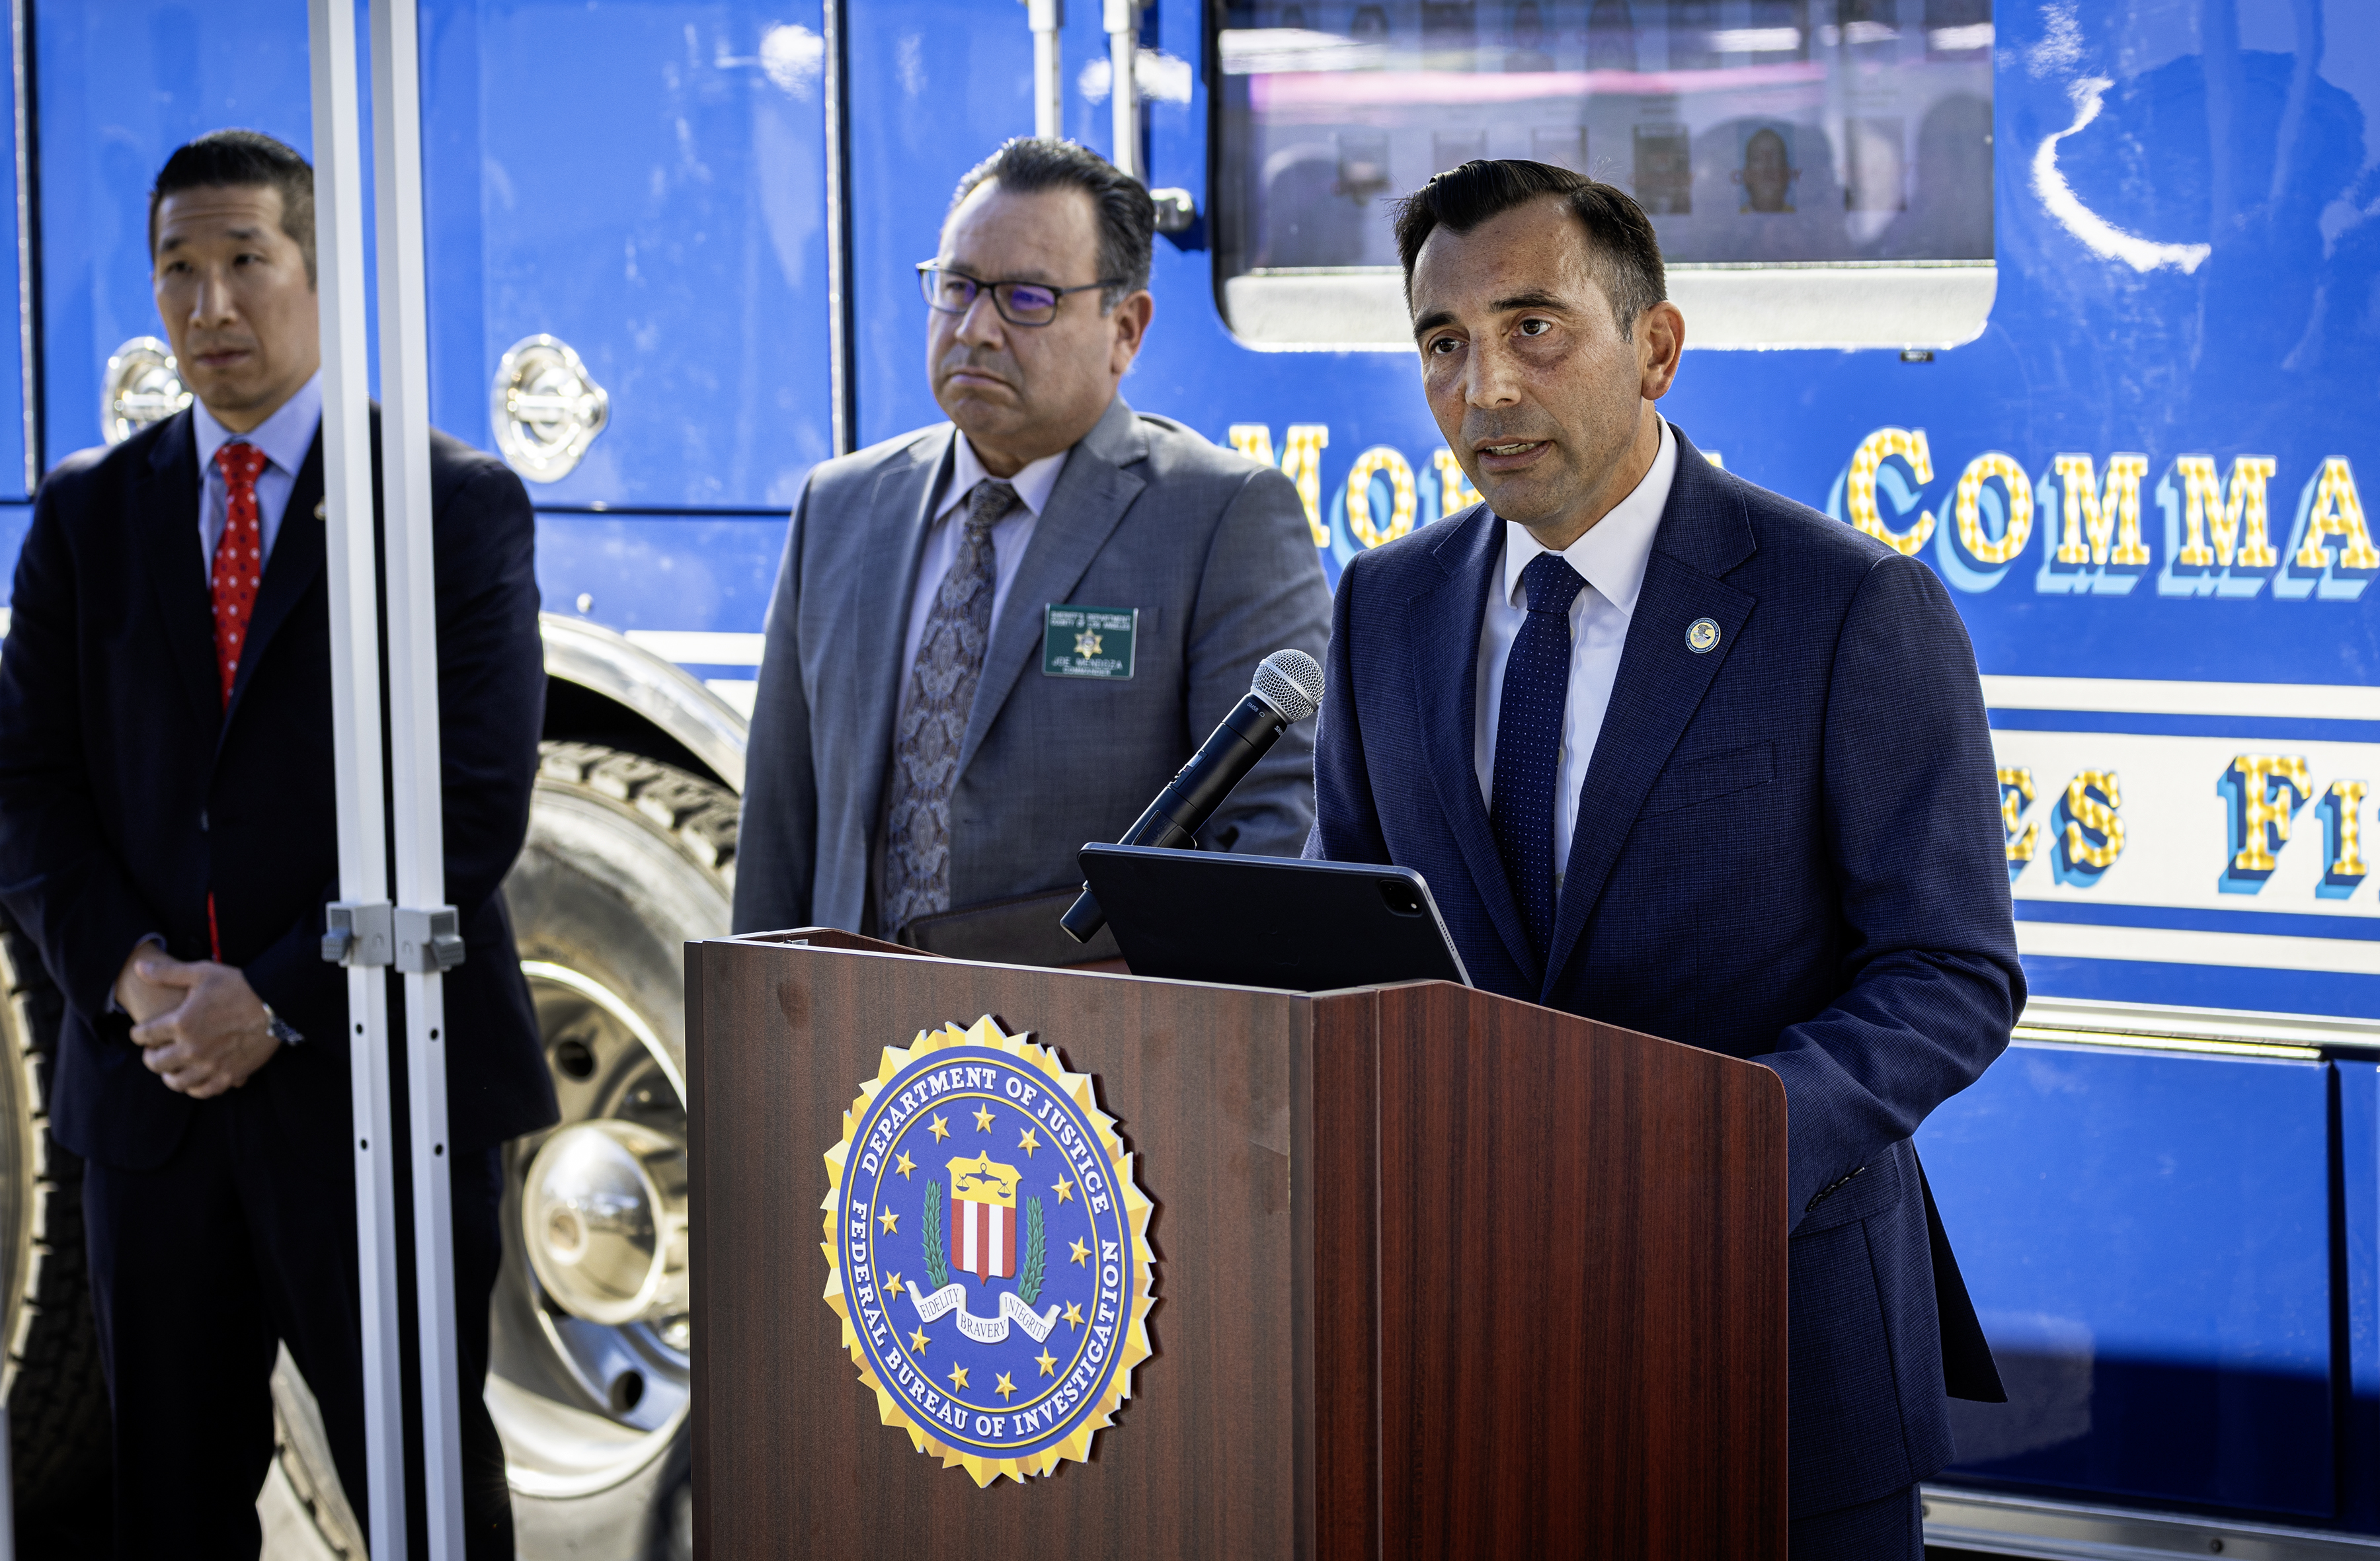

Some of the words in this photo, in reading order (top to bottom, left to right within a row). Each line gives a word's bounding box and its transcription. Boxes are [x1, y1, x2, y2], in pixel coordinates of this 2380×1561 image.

[1847, 425, 2380, 569] COMMA
[1246, 701, 1259, 713] SM58
[861, 1066, 997, 1178] DEPARTMENT
[1006, 1076, 1038, 1106] OF
[1037, 1099, 1110, 1215] JUSTICE
[851, 1199, 889, 1347] FEDERAL
[885, 1347, 969, 1430] BUREAU
[975, 1416, 1005, 1437] OF
[1013, 1239, 1119, 1435] INVESTIGATION
[920, 1288, 959, 1319] FIDELITY
[960, 1312, 1007, 1338] BRAVERY
[1005, 1297, 1051, 1340] INTEGRITY
